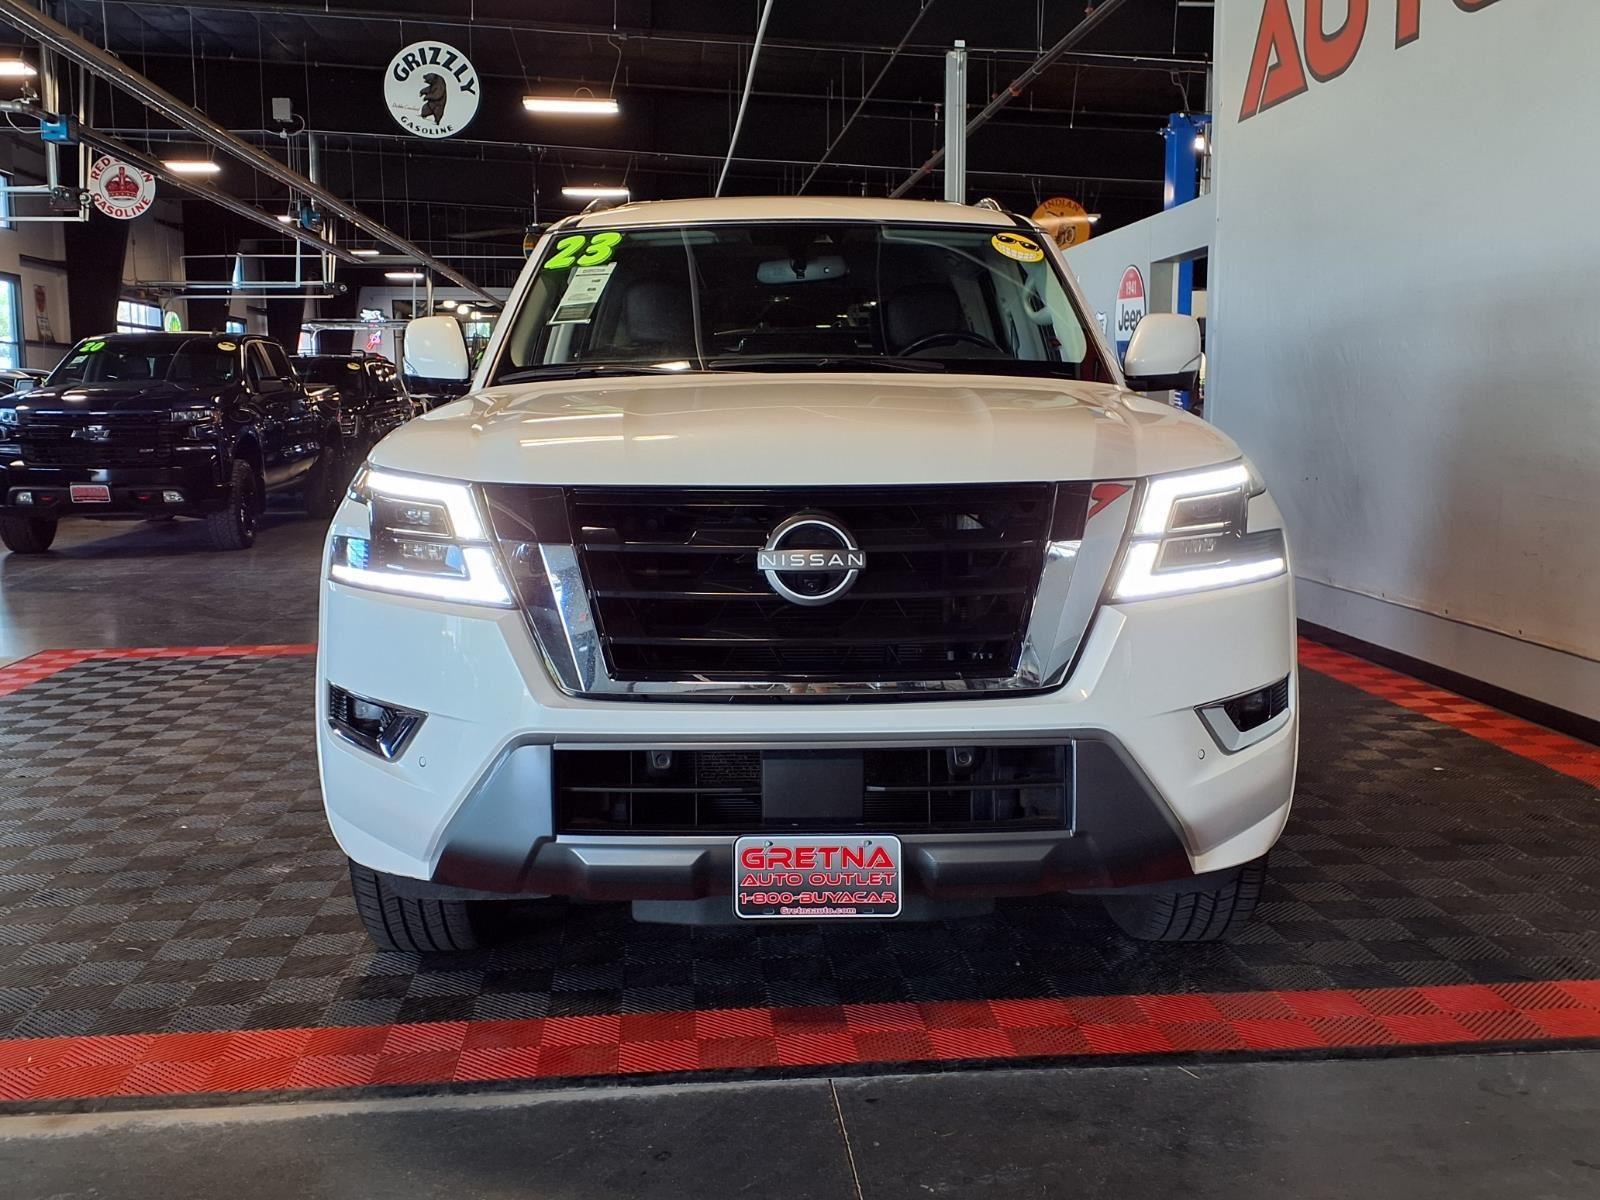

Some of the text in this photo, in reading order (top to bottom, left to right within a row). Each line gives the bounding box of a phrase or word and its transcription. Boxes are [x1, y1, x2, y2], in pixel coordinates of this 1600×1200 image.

[393, 46, 476, 95] GRIZZLY
[1237, 0, 1500, 124] AU
[400, 115, 454, 135] GASOLINE
[91, 157, 111, 180] RED
[93, 192, 151, 217] GASOLINE
[1043, 199, 1084, 212] INDIAN
[543, 232, 622, 270] 23
[79, 341, 105, 352] 20
[761, 553, 863, 566] NISSAN
[740, 846, 895, 870] GRETNA
[740, 872, 897, 887] AUTO OUTLET
[739, 891, 897, 904] 1-800-BUYACAR
